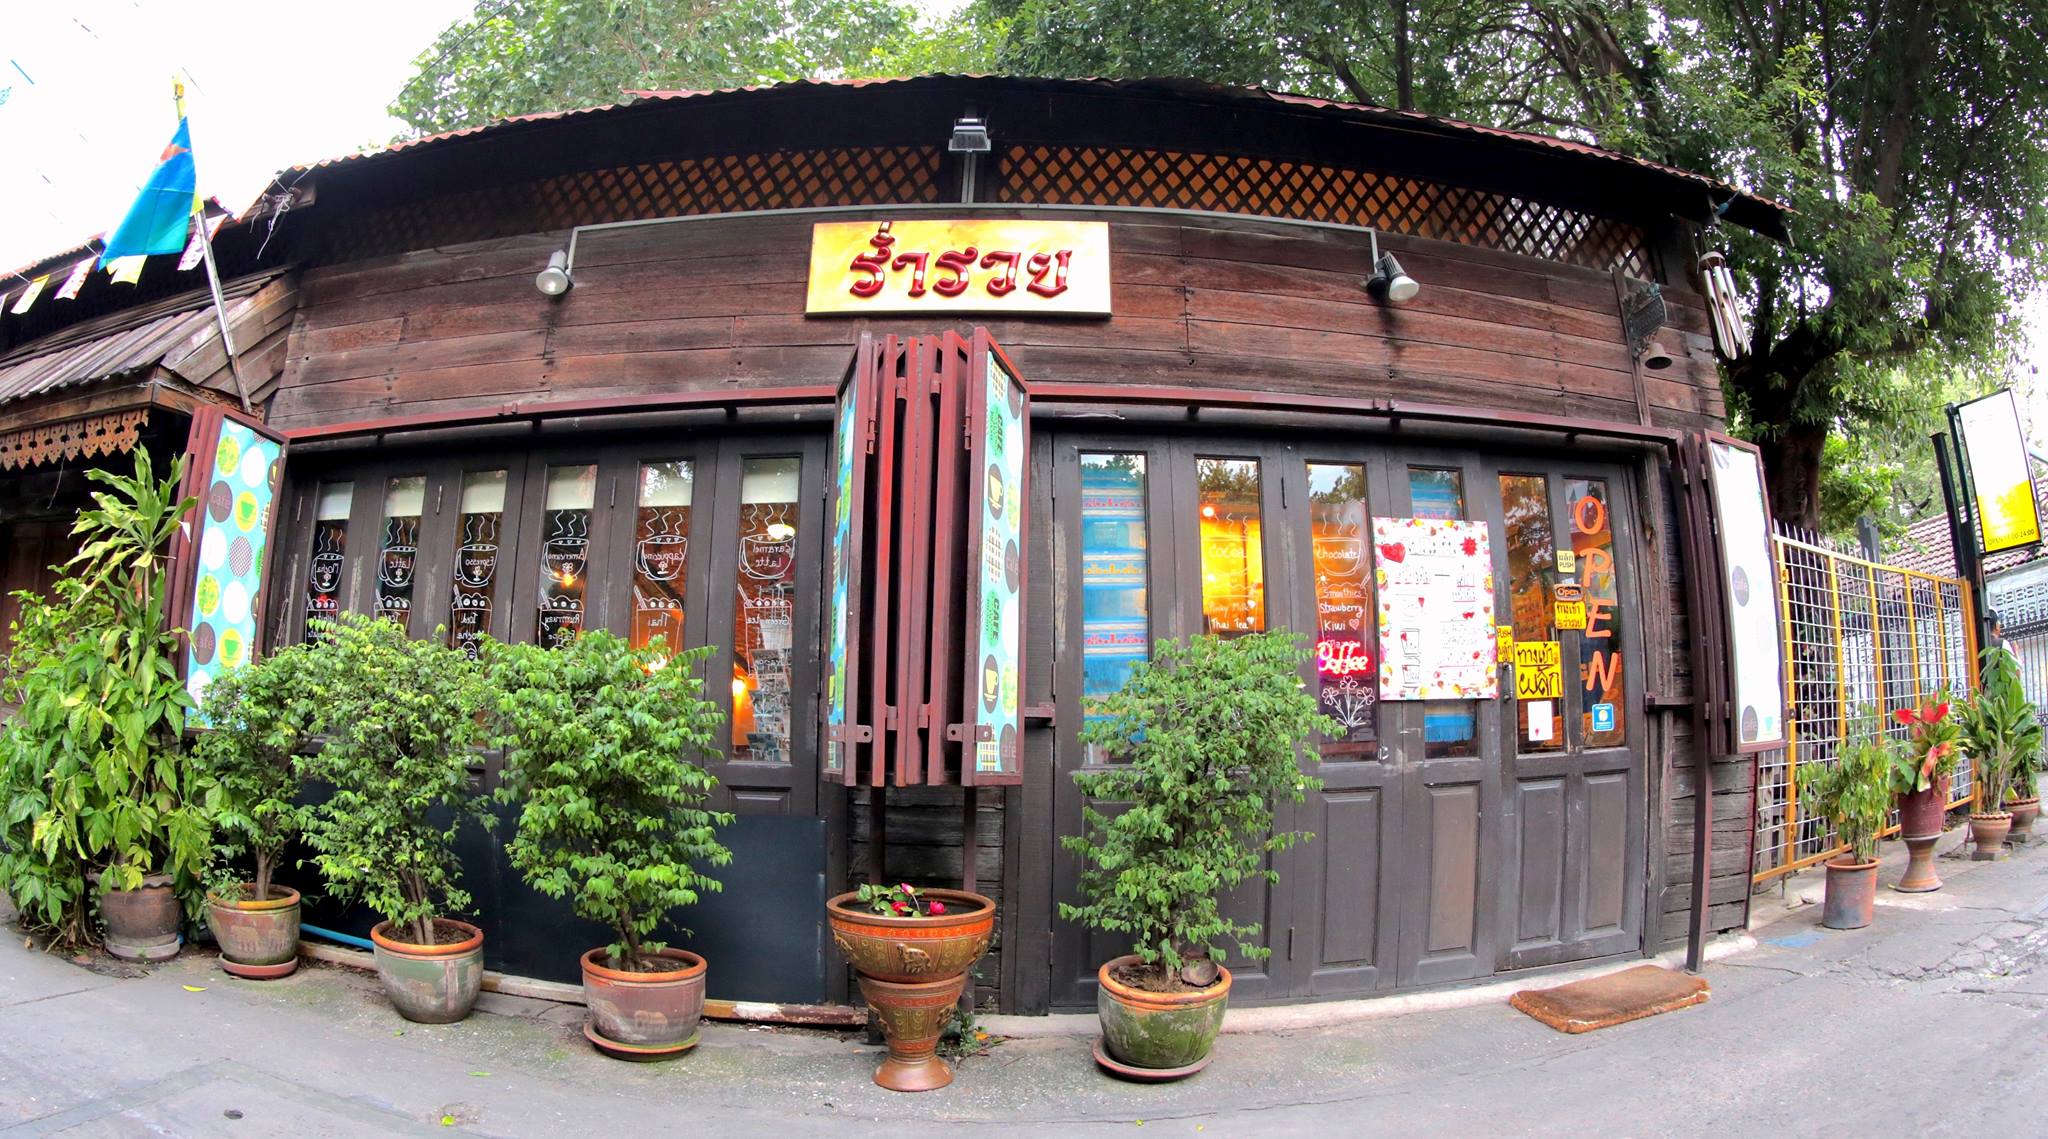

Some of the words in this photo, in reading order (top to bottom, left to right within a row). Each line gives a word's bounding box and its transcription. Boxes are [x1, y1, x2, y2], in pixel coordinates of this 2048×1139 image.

[850, 221, 1072, 298] ร่ำรวย
[1316, 544, 1361, 560] Chocolate
[1557, 588, 1579, 597] Open
[1573, 495, 1619, 692] OPEN
[1319, 602, 1364, 619] Strawberry
[1211, 617, 1230, 629] Thai
[1233, 617, 1249, 629] Tea
[1324, 619, 1346, 631] Kiwi
[1517, 642, 1553, 664] ทางเข้า
